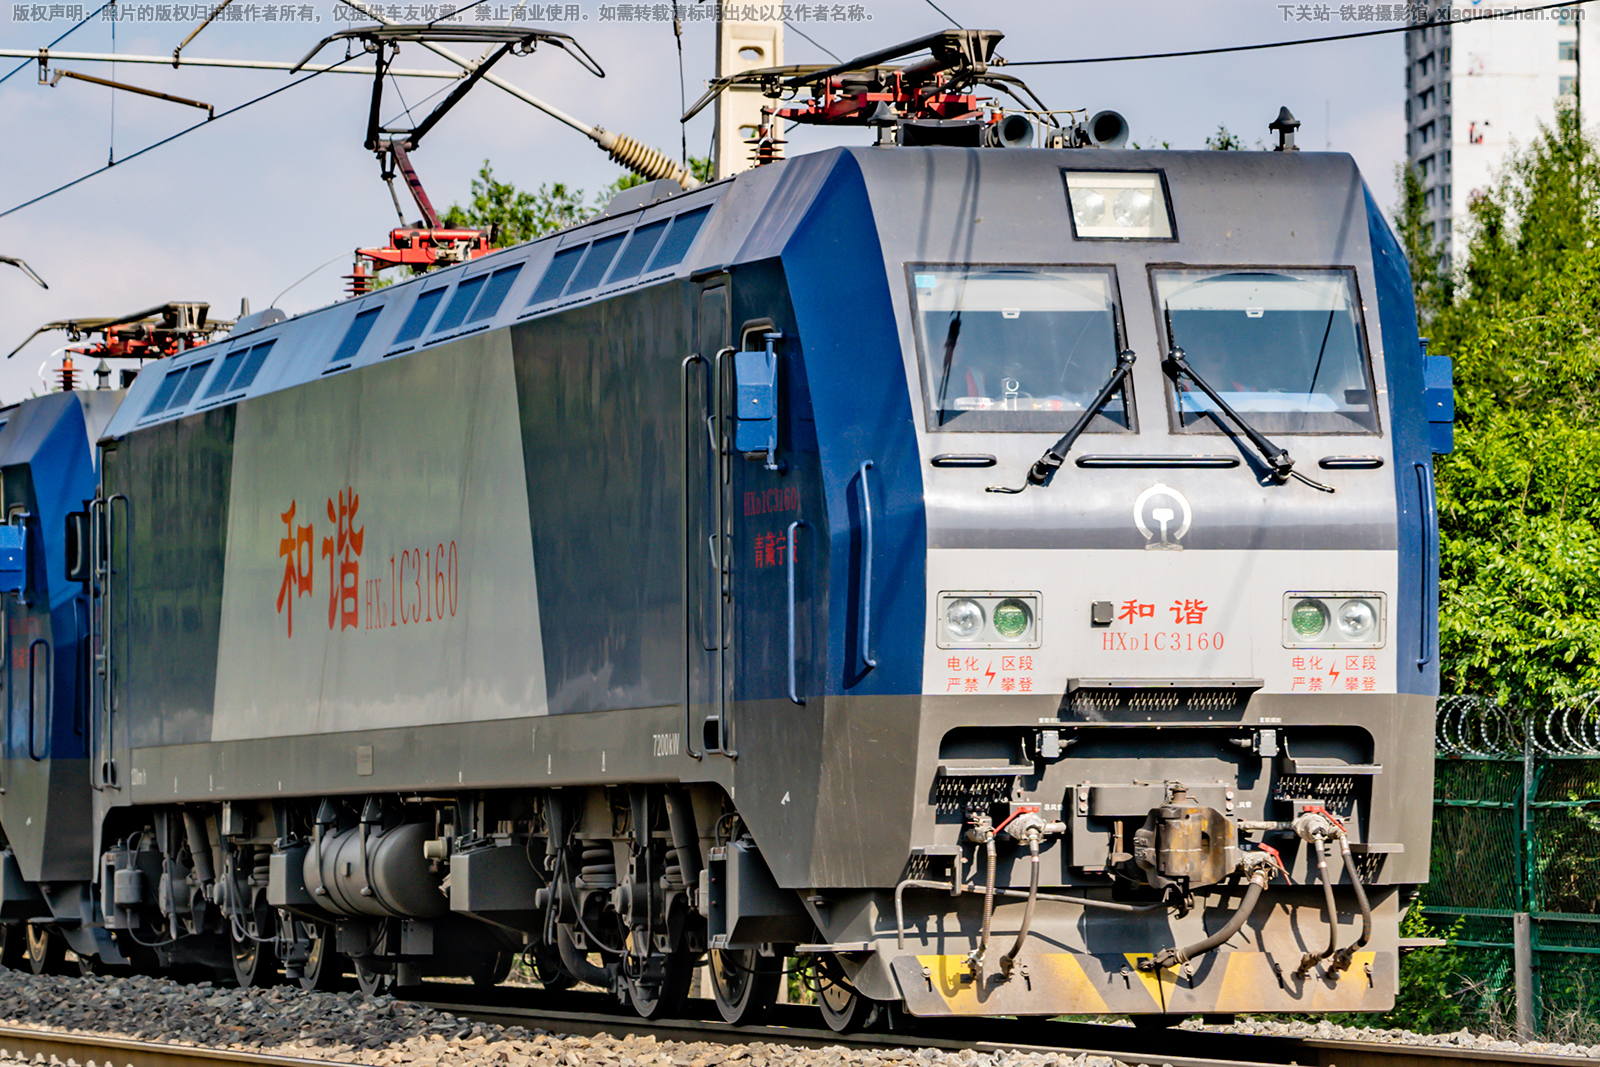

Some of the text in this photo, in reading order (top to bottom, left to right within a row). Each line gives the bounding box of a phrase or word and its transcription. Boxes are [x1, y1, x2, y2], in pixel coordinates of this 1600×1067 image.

[276, 485, 364, 639] 和谐
[1117, 598, 1209, 625] 和谐
[947, 655, 1034, 672] 电化 区段
[1291, 654, 1377, 671] 电化 区段
[946, 676, 1034, 693] 严禁 攀登
[1290, 676, 1377, 692] 严禁 攀登
